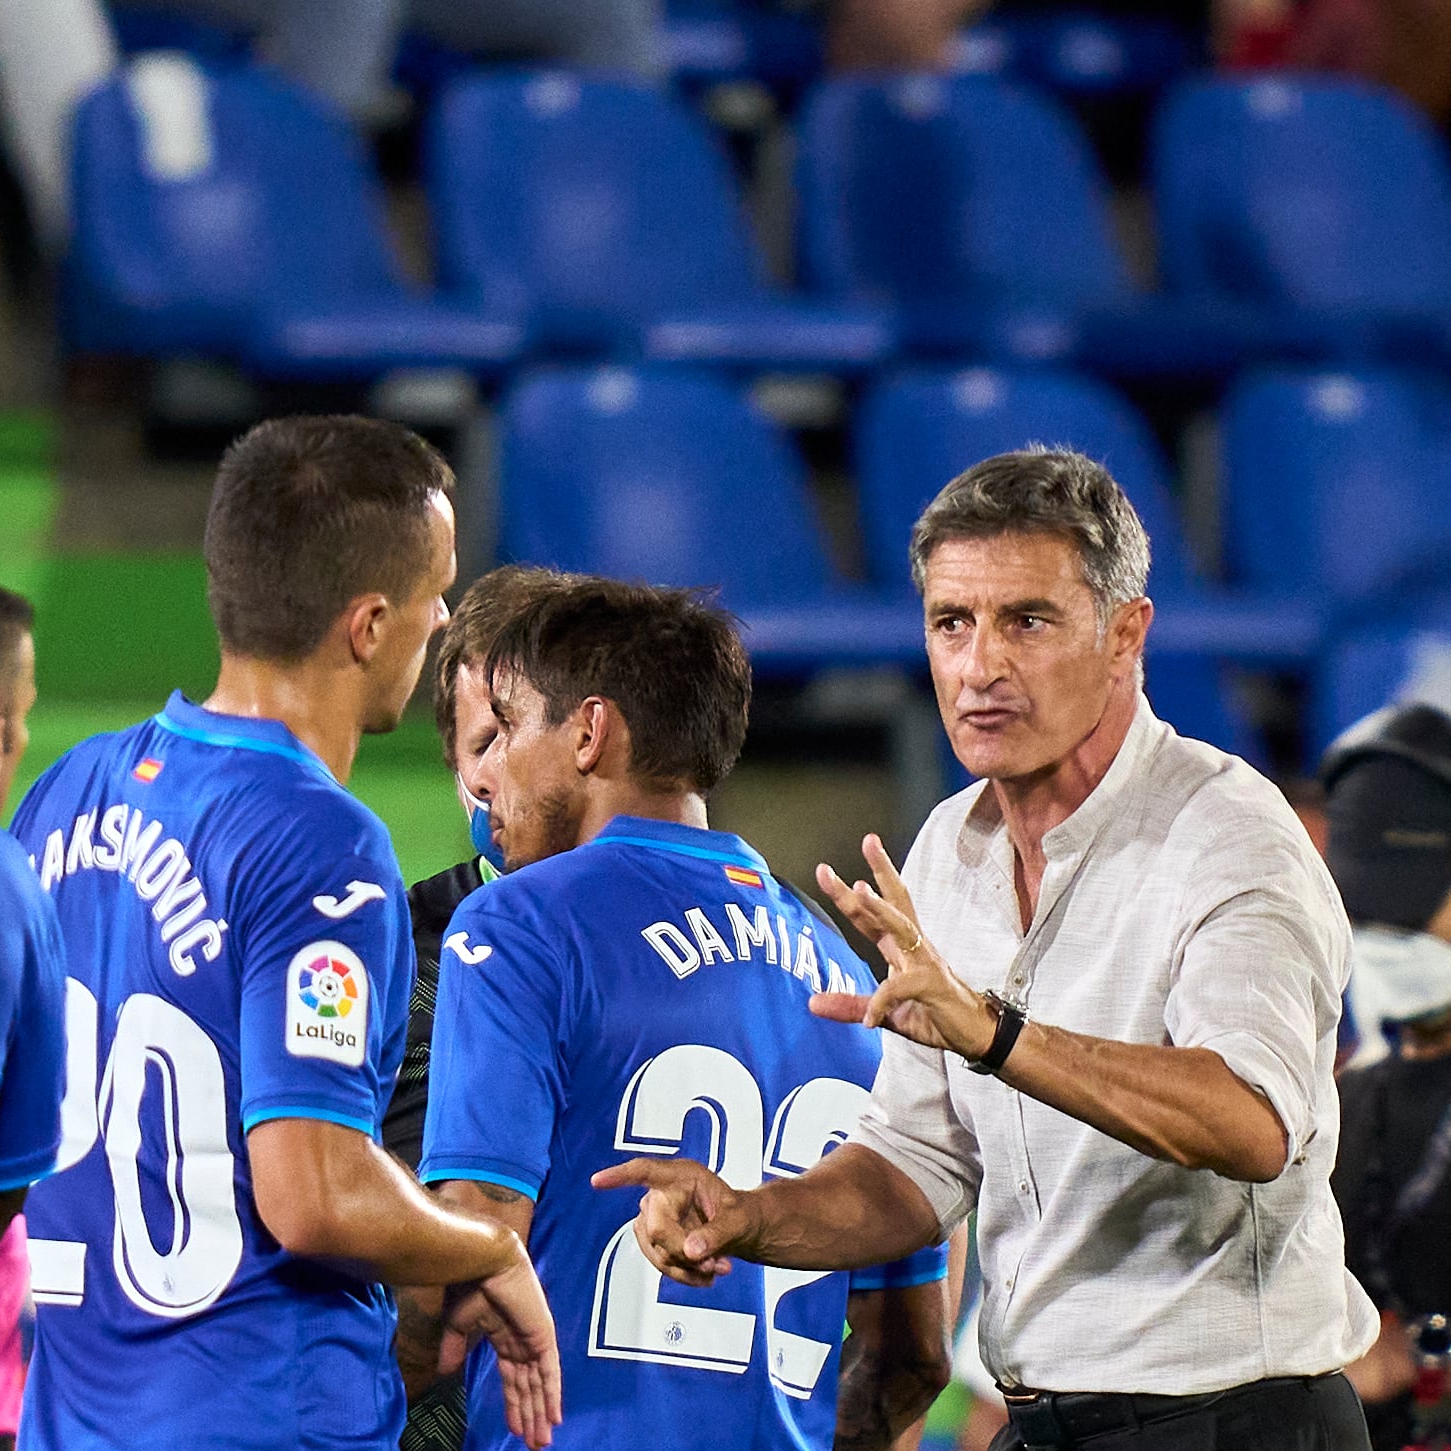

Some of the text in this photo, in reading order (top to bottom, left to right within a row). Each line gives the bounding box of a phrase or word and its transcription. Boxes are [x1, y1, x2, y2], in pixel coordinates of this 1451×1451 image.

[29, 803, 229, 977] AKSMOVIĆ
[296, 1022, 356, 1047] LaLiga
[587, 1044, 871, 1401] 22
